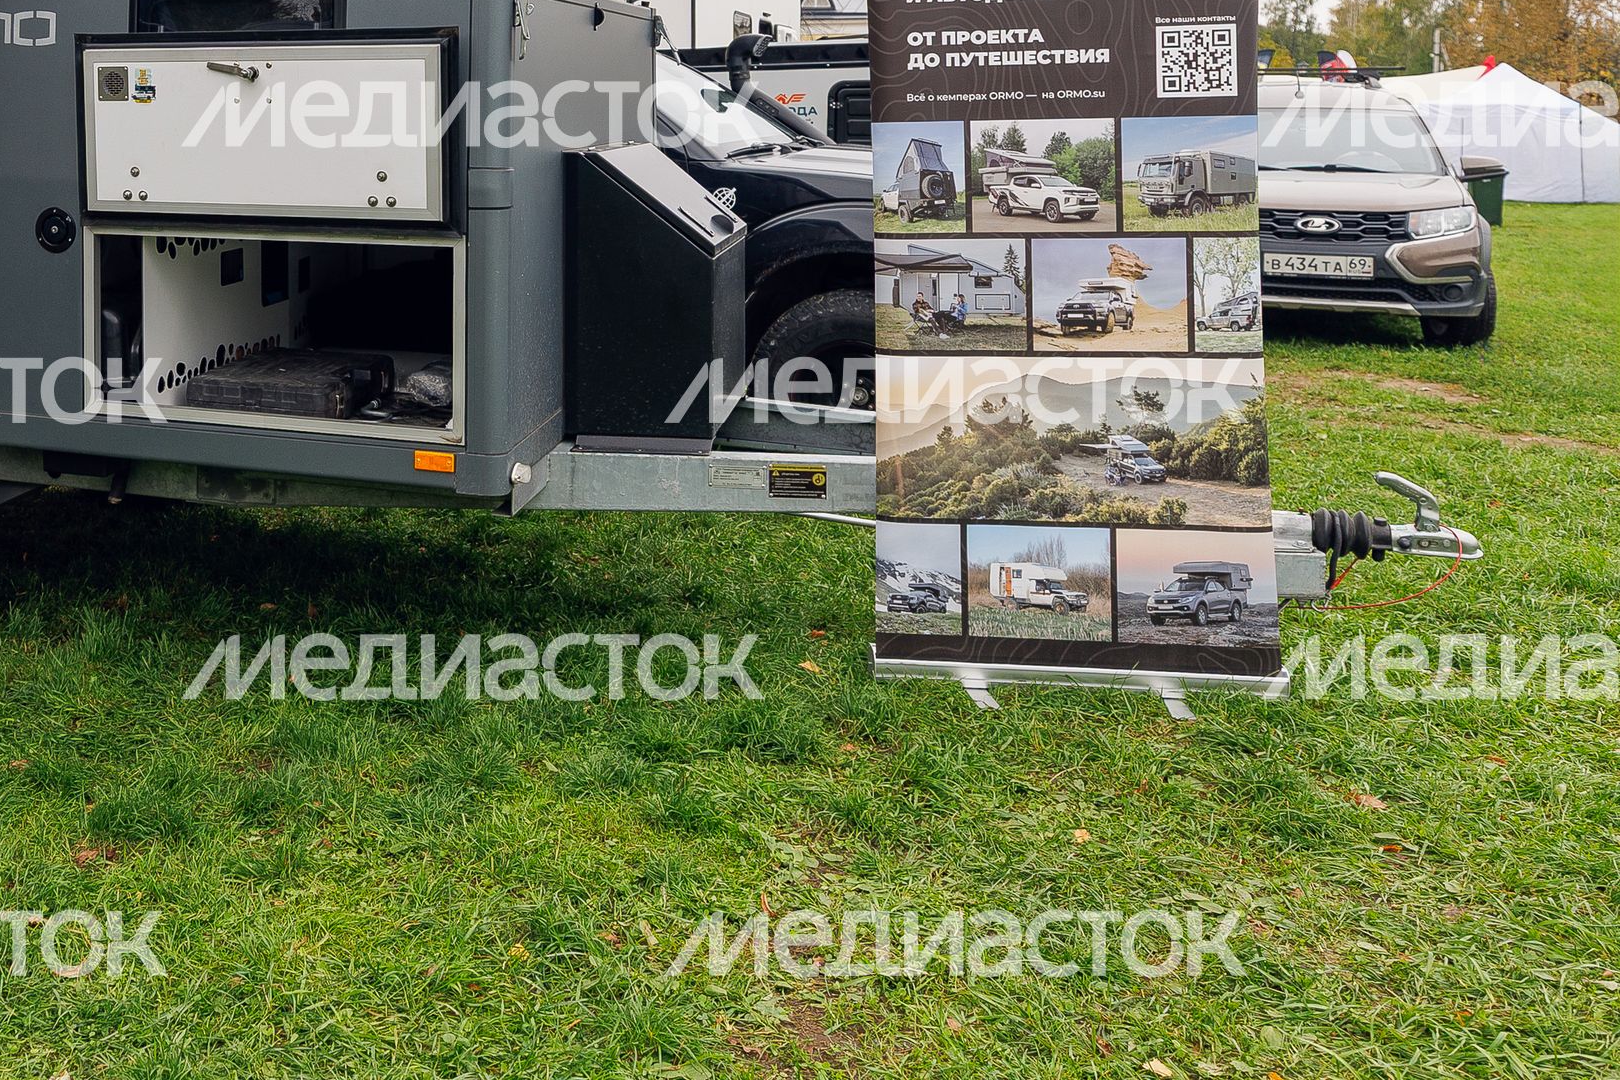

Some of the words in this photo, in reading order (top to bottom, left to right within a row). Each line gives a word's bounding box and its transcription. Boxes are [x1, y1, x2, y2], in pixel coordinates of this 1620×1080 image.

[1197, 15, 1236, 23] контакты
[906, 31, 937, 47] ОТ
[941, 28, 1045, 46] ПРОЕКТА
[907, 52, 941, 71] ДО
[945, 48, 1111, 69] ПУТЕШЕСТВИЯ
[906, 92, 926, 102] Всё
[936, 93, 988, 103] кемперах
[989, 91, 1024, 101] ORMO
[1042, 92, 1055, 100] на
[1056, 90, 1106, 100] ORMO.su
[1348, 258, 1367, 270] 69
